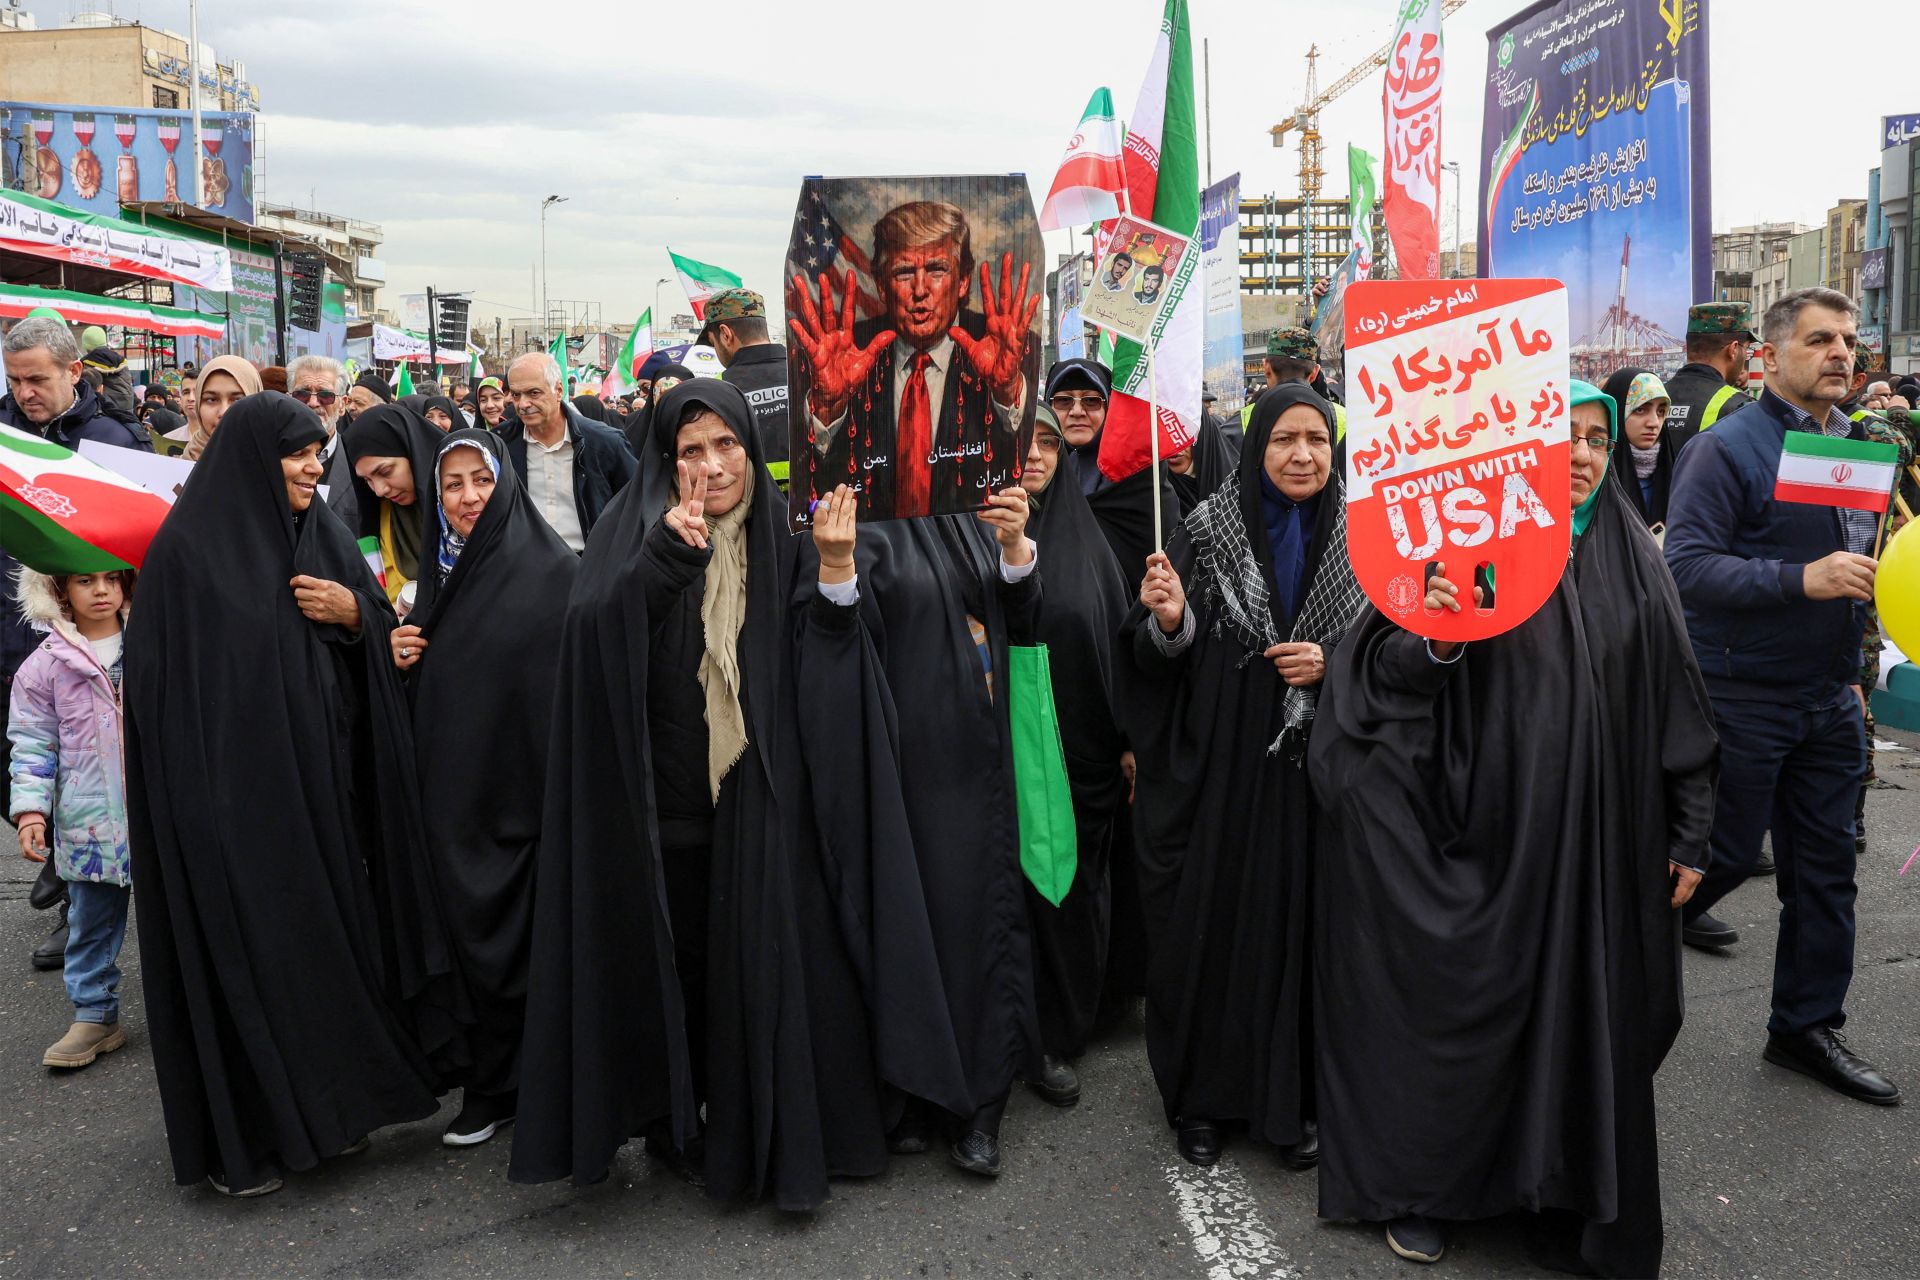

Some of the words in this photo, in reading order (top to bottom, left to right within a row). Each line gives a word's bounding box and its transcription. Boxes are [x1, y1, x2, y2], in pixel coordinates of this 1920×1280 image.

[1578, 152, 1609, 183] ظرفیت
[1610, 138, 1647, 177] افزایش
[1524, 170, 1548, 194] اسکله
[1548, 176, 1555, 194] و
[1556, 165, 1578, 188] بندر
[1646, 177, 1657, 200] به
[1556, 193, 1588, 223] میلیون
[1610, 180, 1621, 211] از
[1621, 178, 1643, 207] بیش
[19, 212, 59, 237] خاتم
[1511, 207, 1529, 233] سال
[1530, 207, 1542, 230] در
[1543, 199, 1557, 226] تن
[62, 222, 139, 256] سازندگی
[141, 238, 200, 270] قرارگاه
[1391, 295, 1444, 330] خمینی
[1446, 282, 1479, 314] امام
[1509, 317, 1553, 357] ما
[1392, 317, 1503, 397] آمریکا
[1356, 363, 1394, 419] را
[1526, 381, 1565, 429] زیر
[1489, 392, 1517, 438] پا
[863, 454, 888, 469] یمن
[927, 441, 986, 464] افغانستان
[976, 468, 1006, 488] ایران
[1382, 467, 1465, 506] DOWN
[1467, 447, 1538, 491] WITH
[1385, 472, 1556, 561] USA
